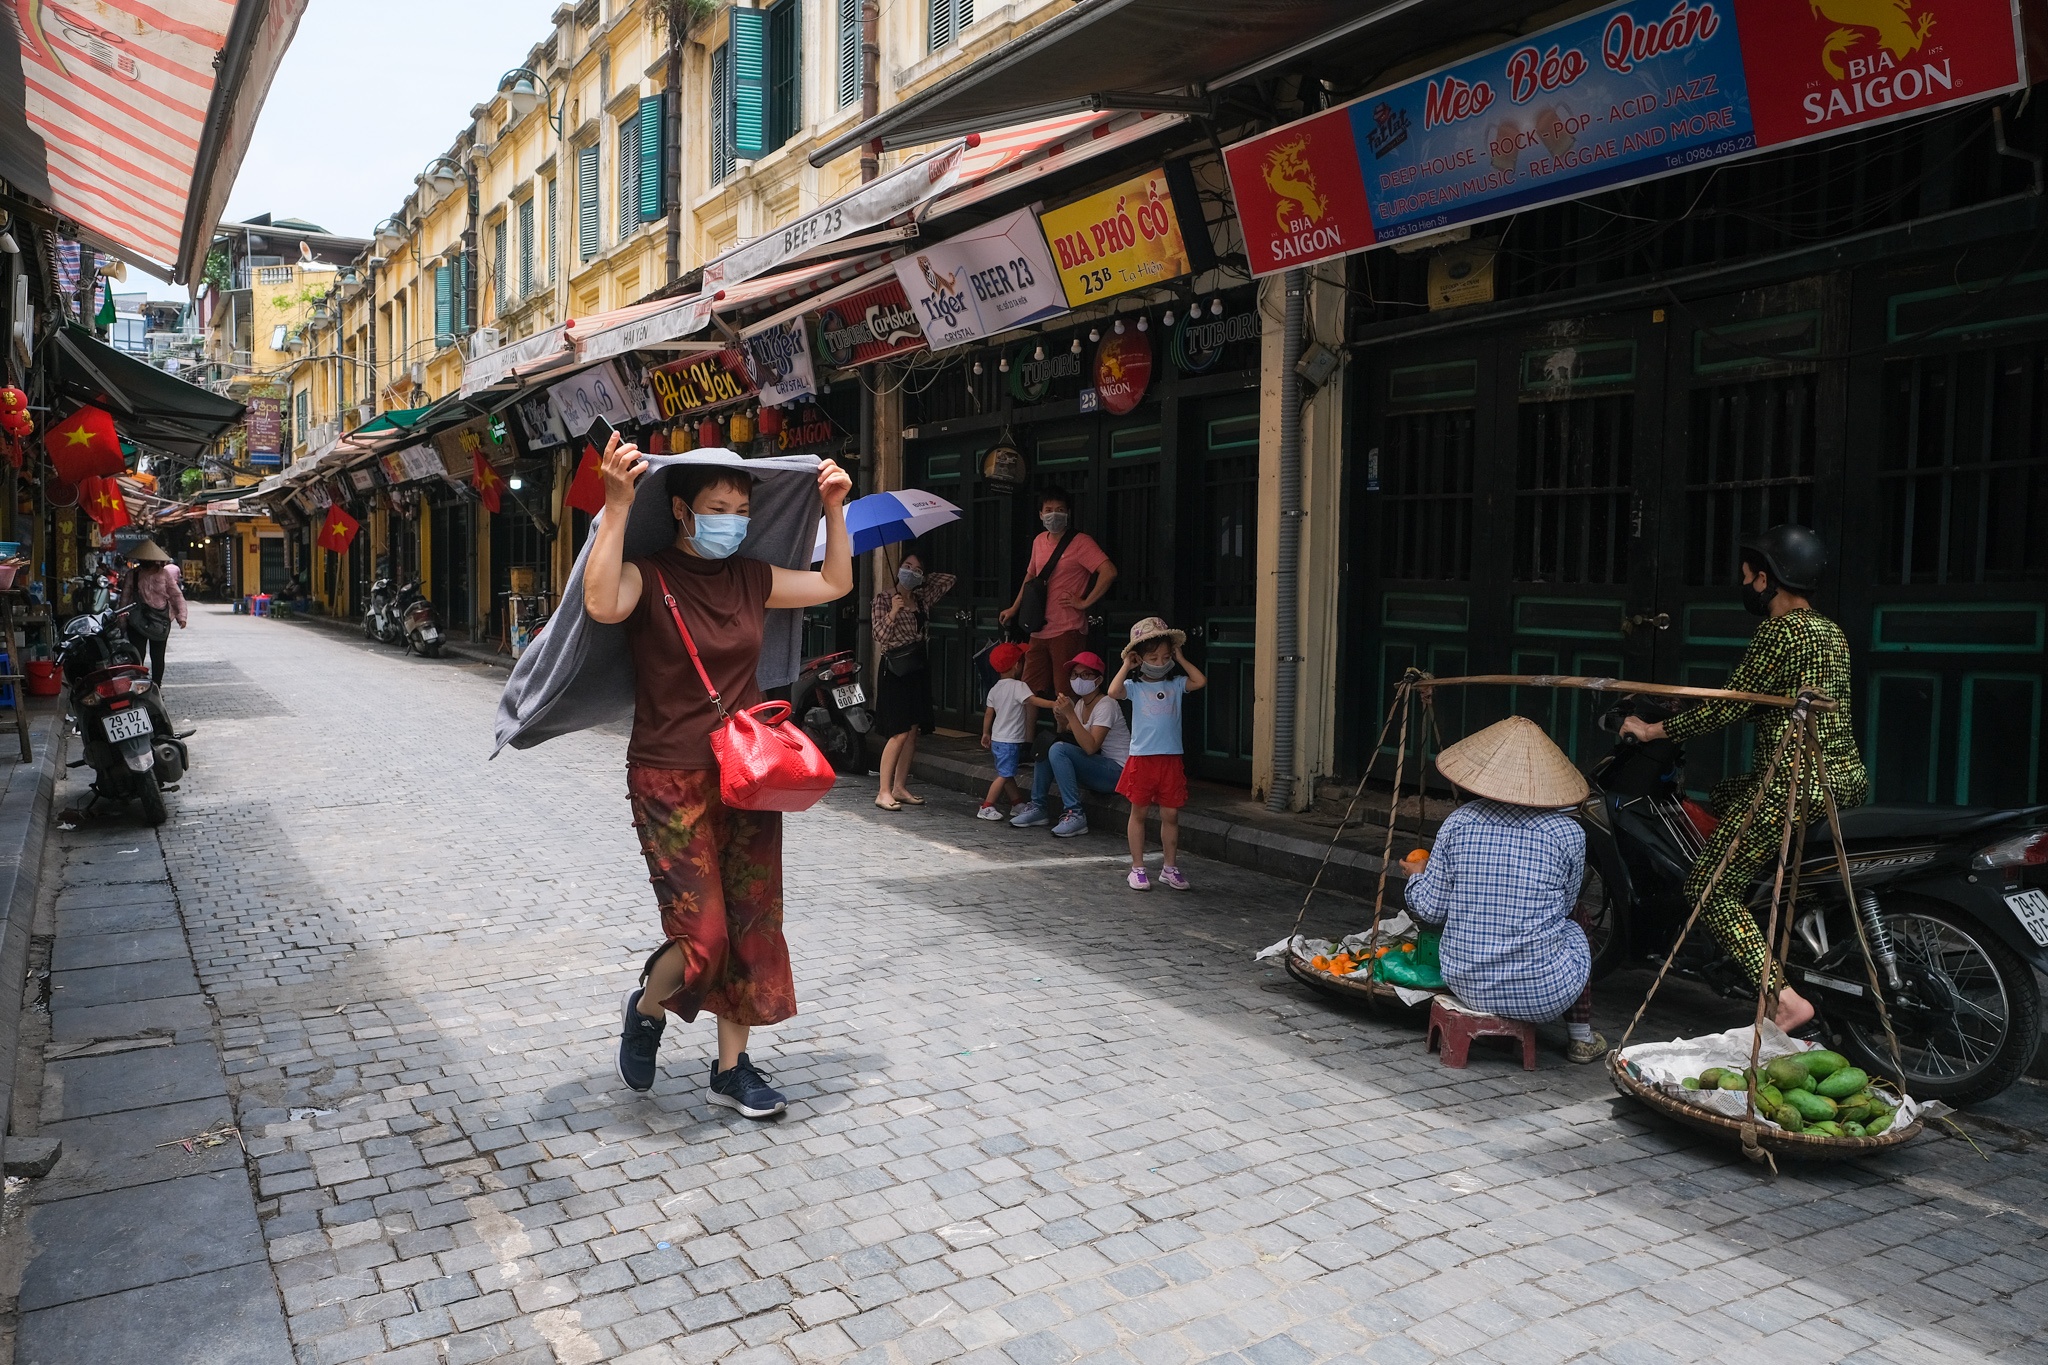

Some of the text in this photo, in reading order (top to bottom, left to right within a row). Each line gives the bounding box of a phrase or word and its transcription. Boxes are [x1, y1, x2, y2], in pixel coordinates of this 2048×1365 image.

[1425, 1, 1720, 130] Mèo Béo Quán
[1848, 51, 1895, 79] BIA
[1802, 58, 1953, 124] SAIGON
[1379, 74, 1718, 190] DEEP HOUSE ROCK POP ACID JAZZ
[1378, 106, 1735, 219] EUROPEAN MUSIC REAGGAE AND MORE
[1665, 155, 1684, 167] Tel:
[784, 208, 842, 254] BEER 23
[1054, 180, 1170, 270] BIA PHỐ CỔ
[1290, 216, 1313, 234] BIA
[1378, 215, 1448, 239] Add: 25 Ta Hien Str
[1271, 225, 1341, 261] SAIGON
[970, 257, 1036, 302] BEER 23
[865, 303, 918, 341] Carlsber
[920, 289, 968, 328] Tiger
[824, 320, 874, 353] TUBORG
[944, 327, 975, 342] CRYSTAL
[1022, 351, 1081, 388] TUBORG
[775, 377, 806, 395] CRYSTAL
[1081, 392, 1096, 409] 23
[803, 409, 817, 422] BIA
[788, 420, 832, 449] SAIGON
[837, 684, 858, 698] 29-C1
[838, 693, 864, 707] 800.16
[109, 711, 141, 728] 29-D2
[110, 721, 149, 740] 151.24
